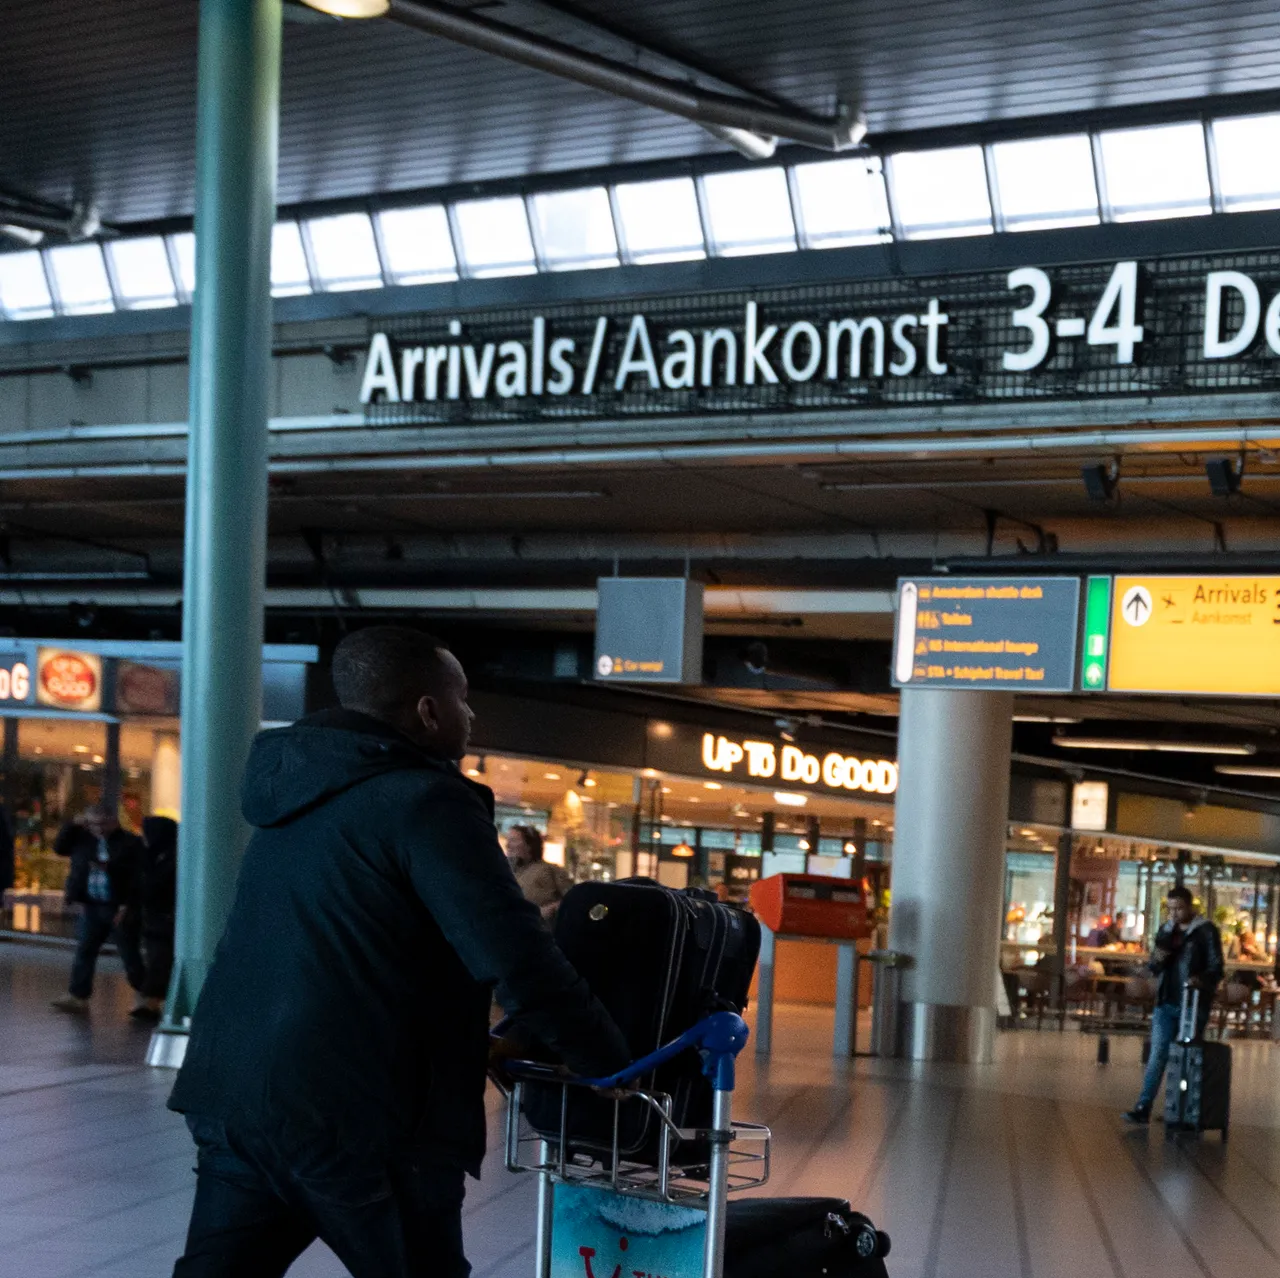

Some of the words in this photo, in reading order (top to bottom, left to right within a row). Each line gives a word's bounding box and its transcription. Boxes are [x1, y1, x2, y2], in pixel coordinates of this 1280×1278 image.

[1002, 261, 1144, 371] 3-4
[1193, 583, 1267, 605] Arrivals
[1191, 611, 1253, 626] Aankomst
